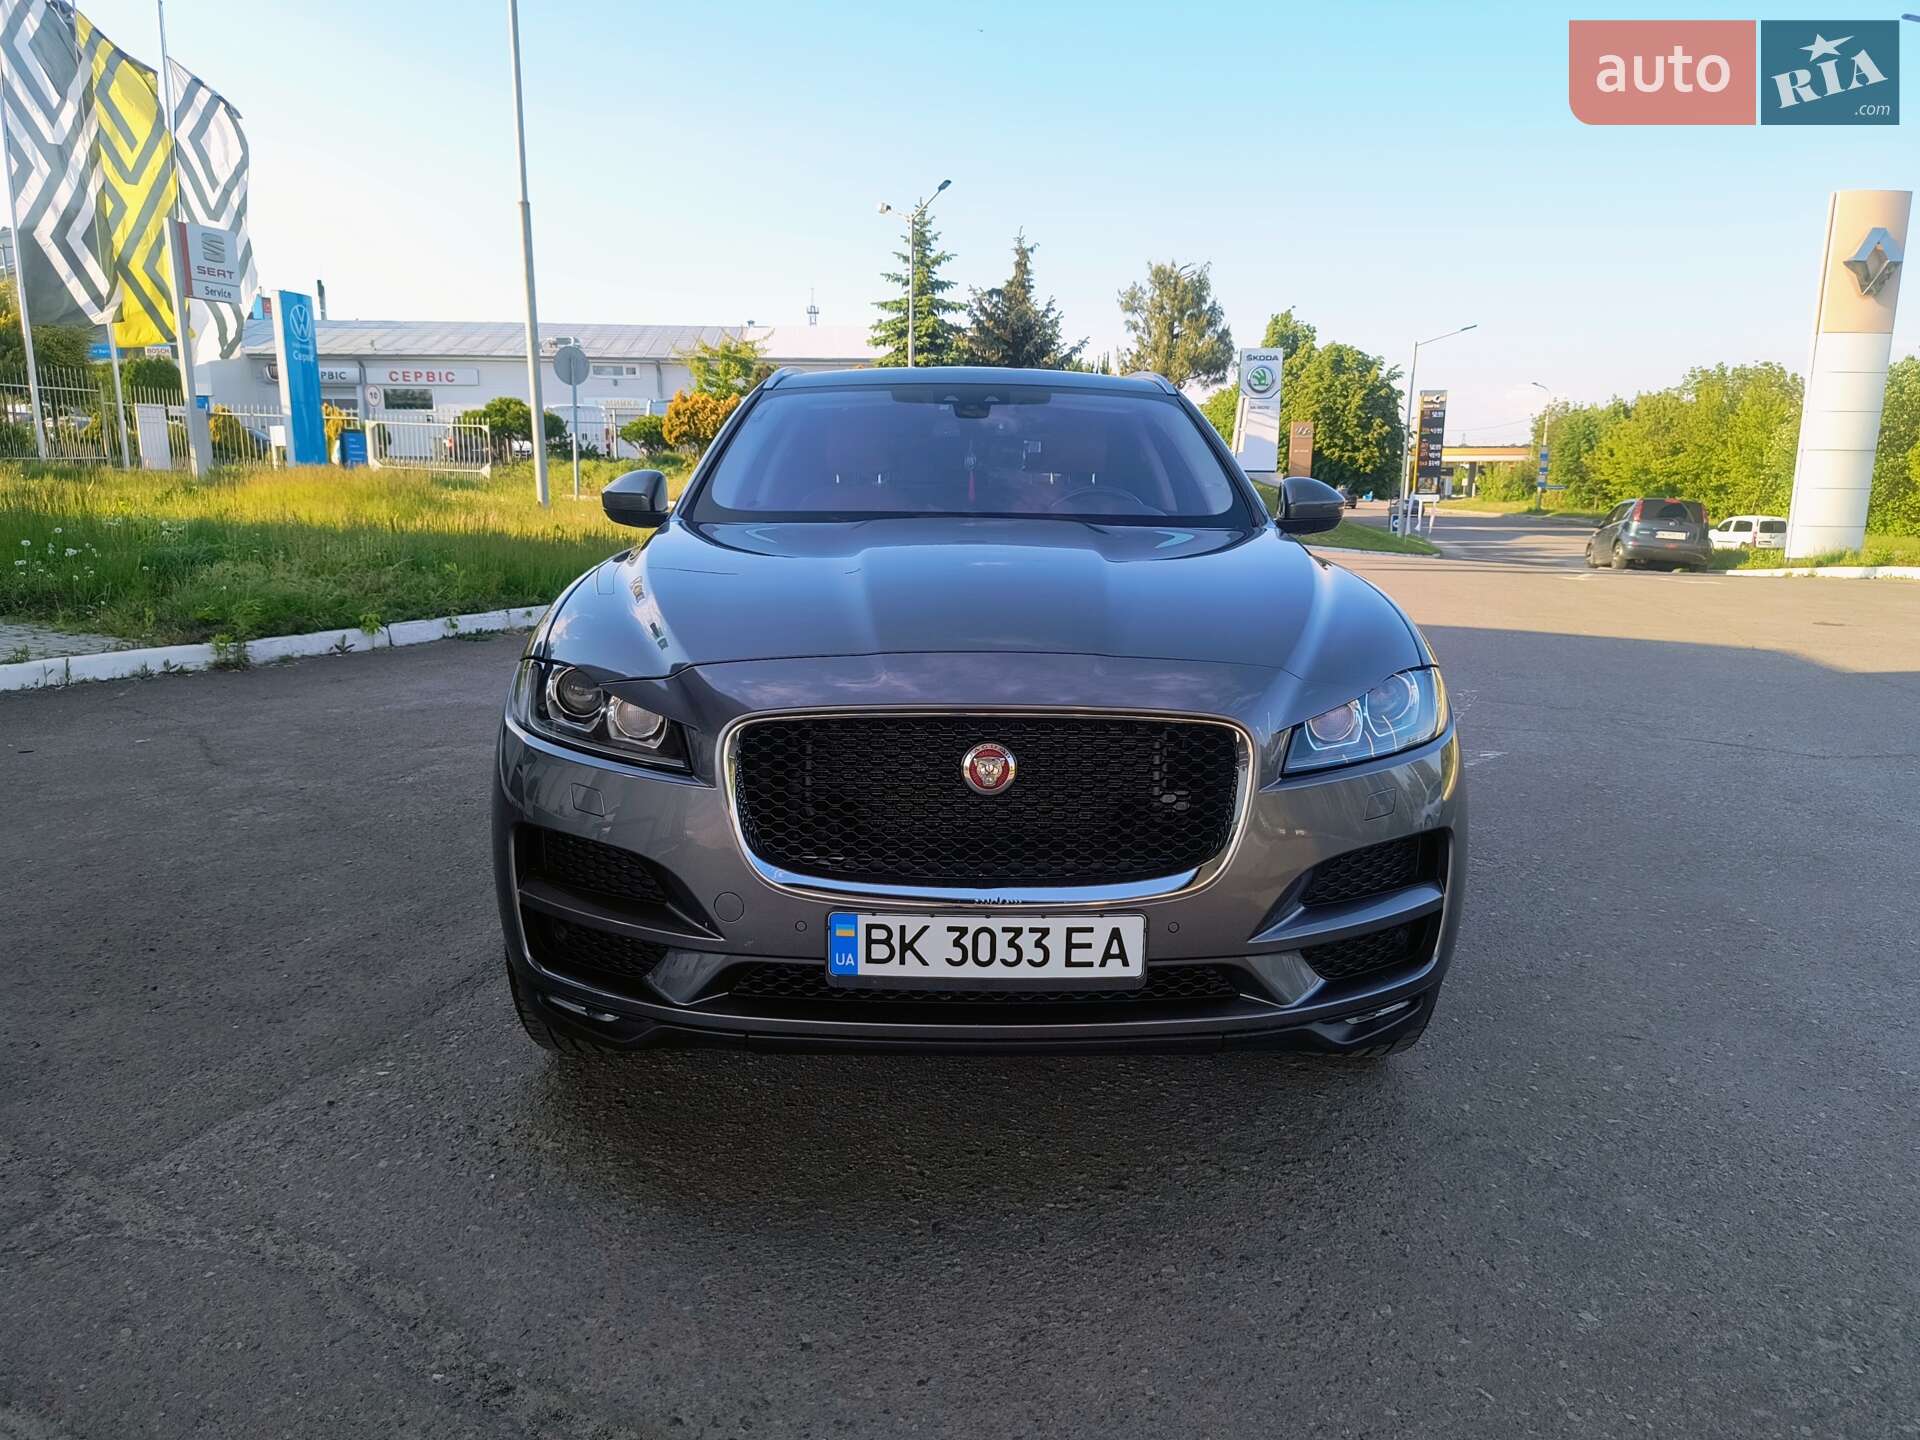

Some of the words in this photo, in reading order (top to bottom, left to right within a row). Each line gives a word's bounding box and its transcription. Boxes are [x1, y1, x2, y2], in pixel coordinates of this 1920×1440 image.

[197, 266, 235, 279] SEAT
[205, 286, 232, 298] Service
[388, 371, 456, 383] СЕРВІС
[369, 391, 378, 400] 10
[864, 923, 931, 967] BK
[945, 926, 1051, 968] 3033
[1064, 926, 1131, 968] EA
[835, 952, 855, 966] UA
